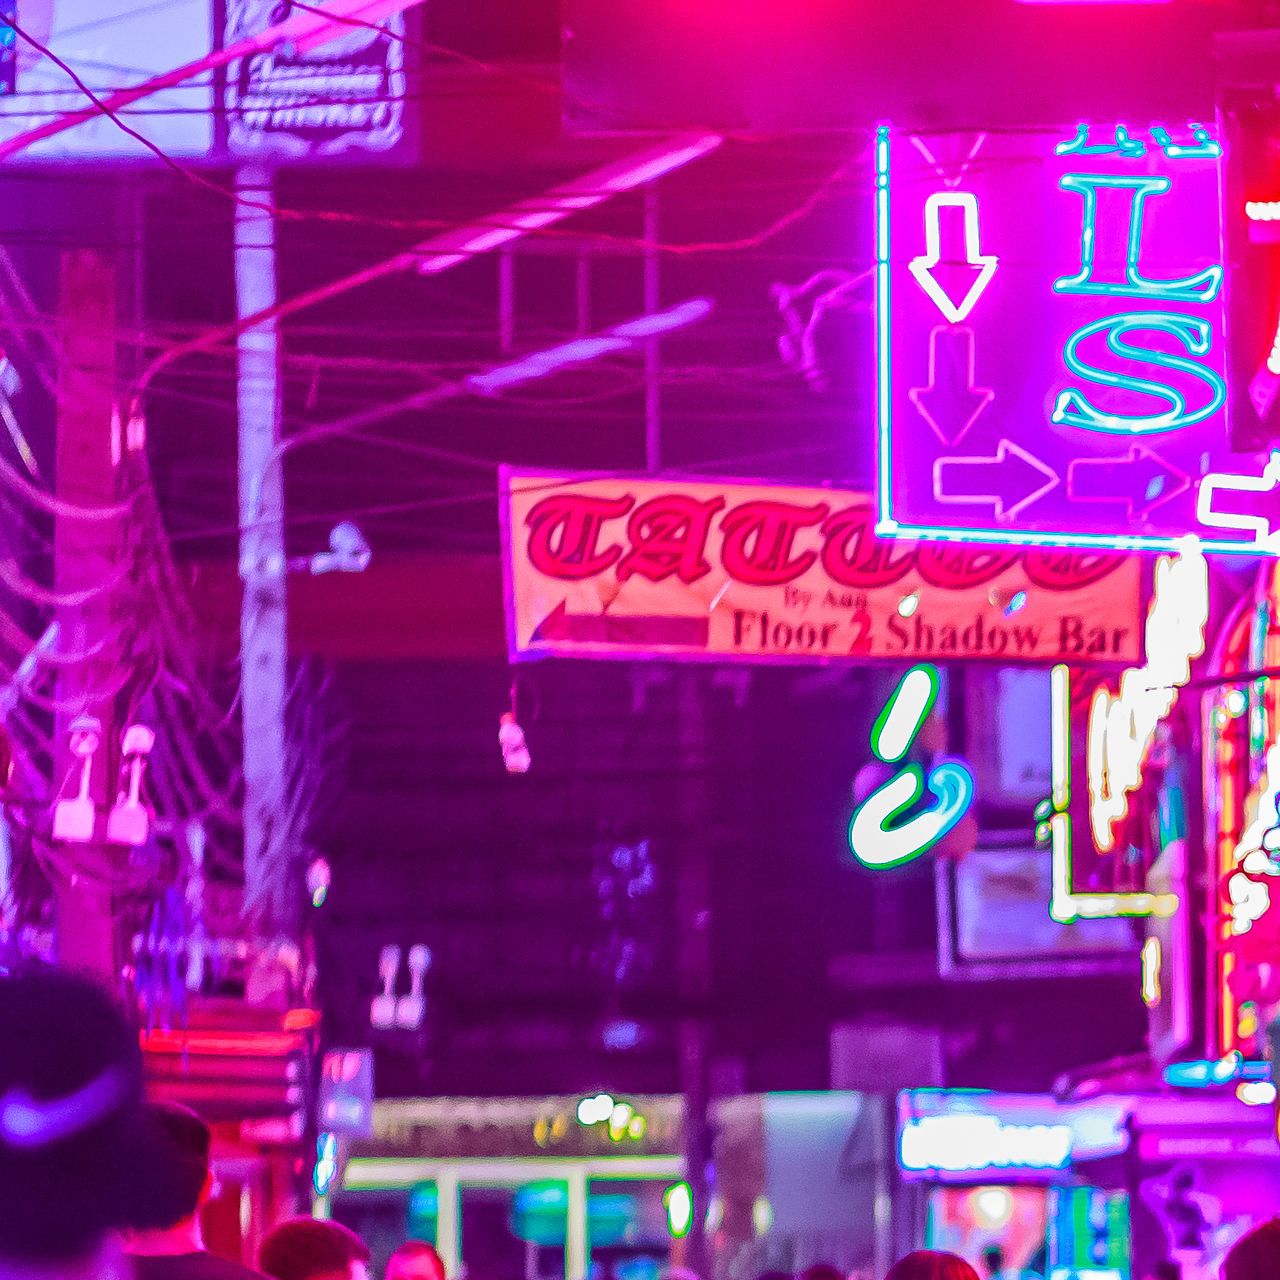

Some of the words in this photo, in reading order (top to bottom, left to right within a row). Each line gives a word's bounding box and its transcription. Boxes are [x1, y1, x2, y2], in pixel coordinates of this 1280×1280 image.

[1052, 124, 1227, 435] LS
[733, 609, 838, 650] Floor
[849, 604, 874, 656] 2
[886, 613, 1041, 652] Shadow
[1059, 615, 1130, 655] Bar
